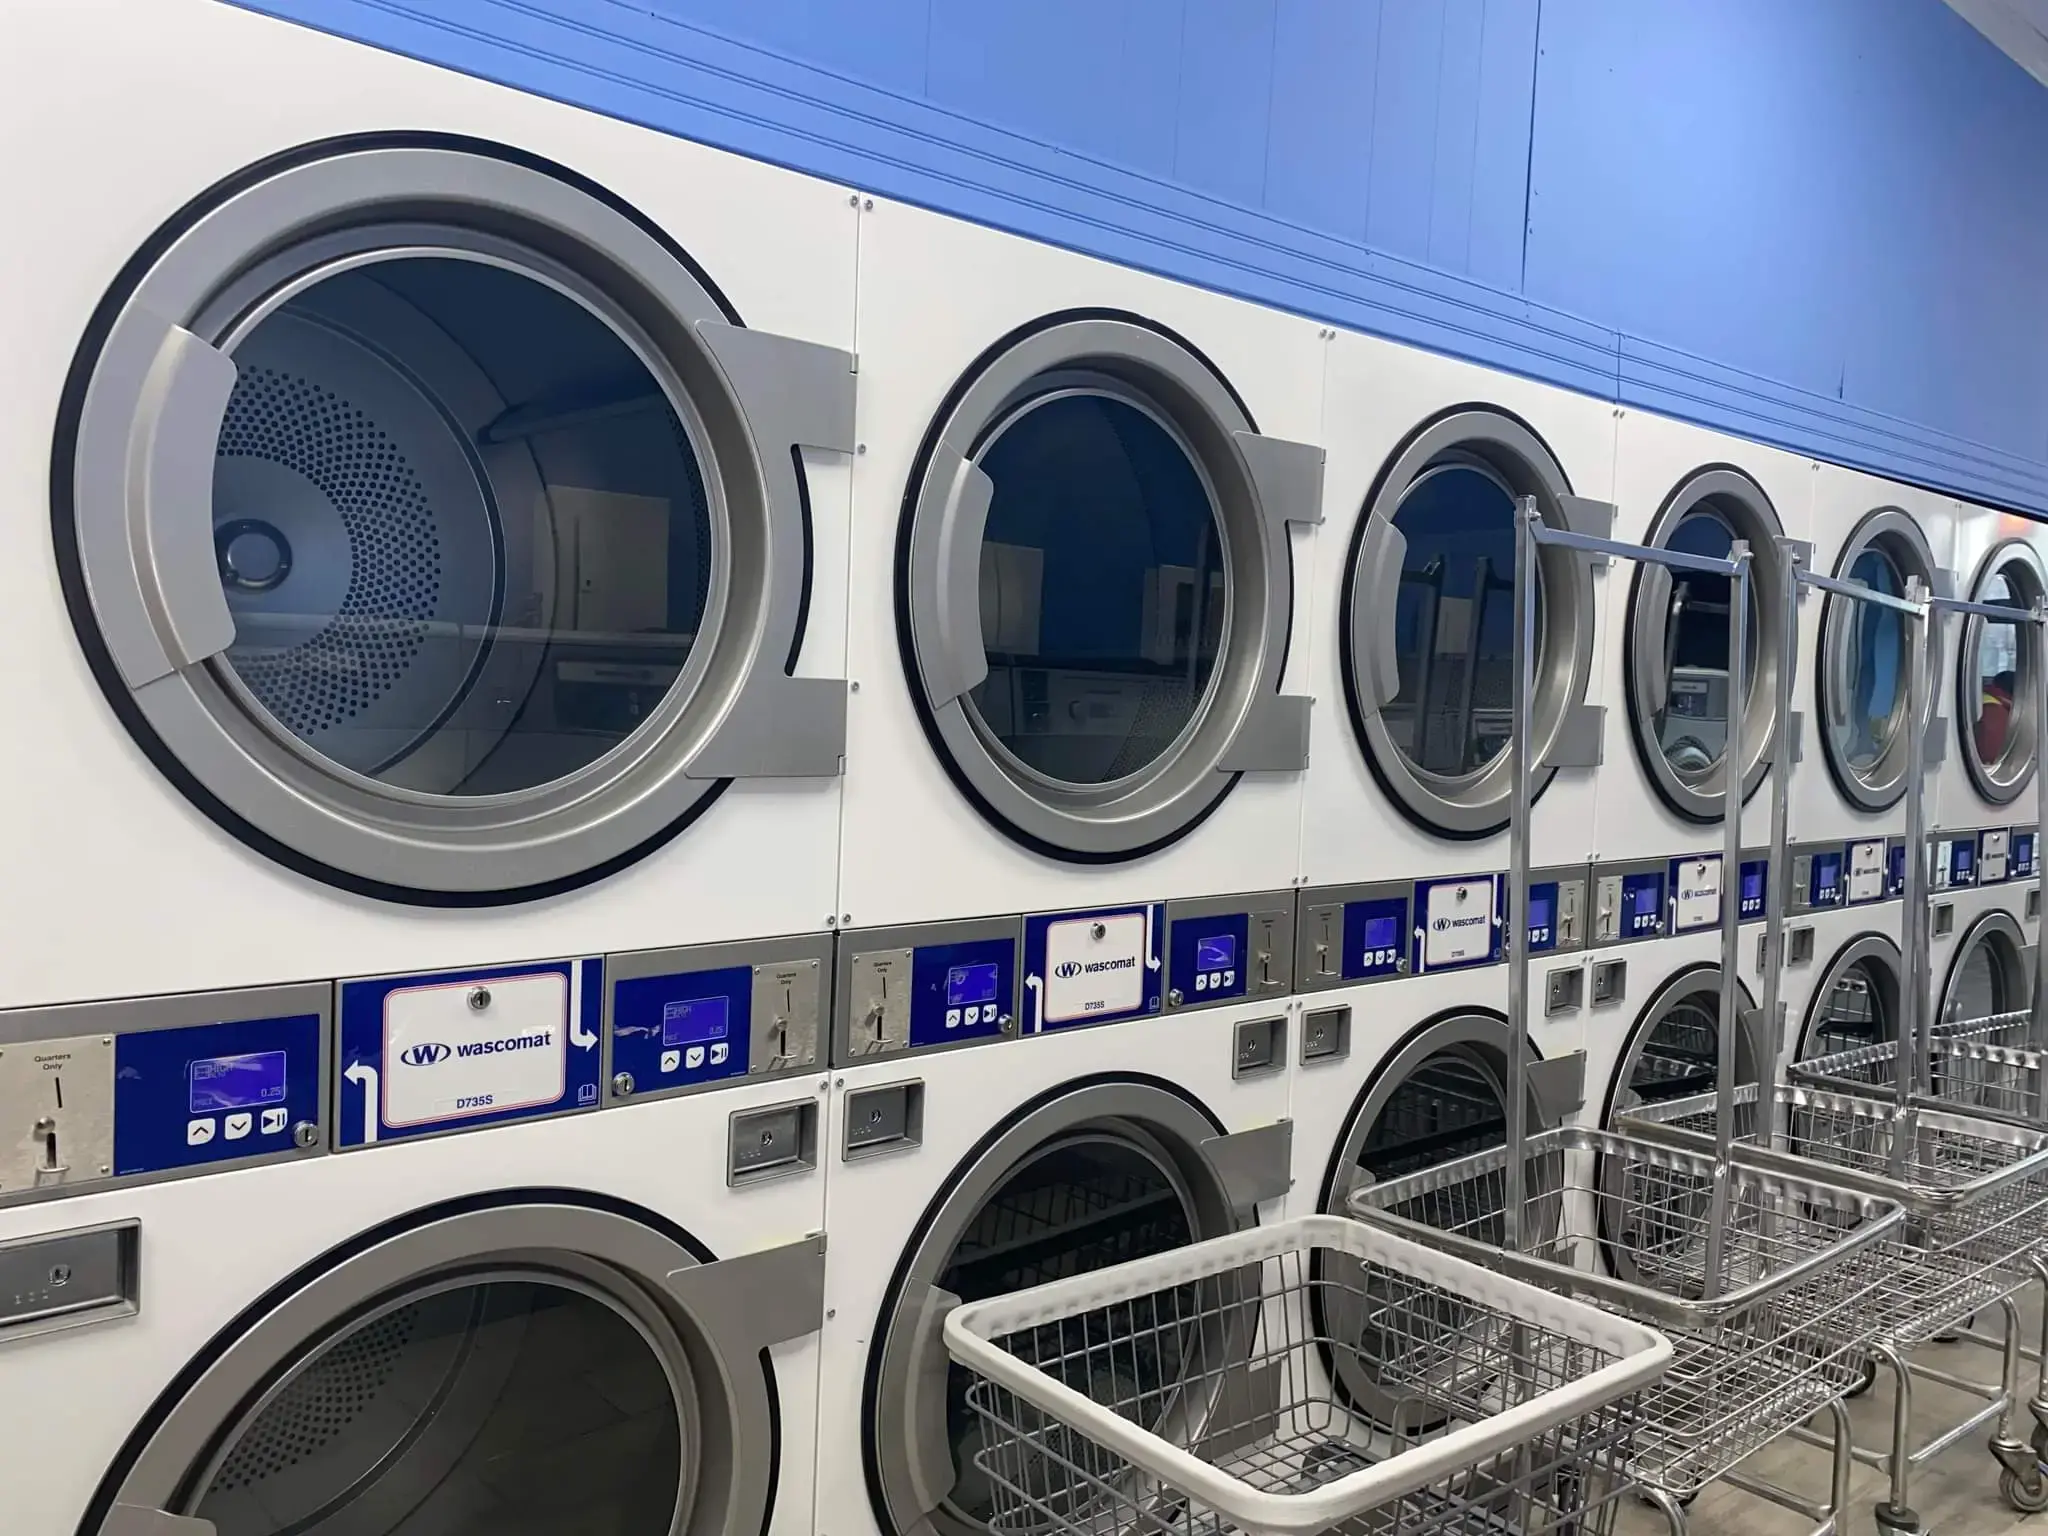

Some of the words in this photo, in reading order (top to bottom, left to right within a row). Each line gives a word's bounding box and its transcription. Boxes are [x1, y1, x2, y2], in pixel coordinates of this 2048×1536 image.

[1084, 956, 1136, 973] wascomat
[1085, 1000, 1105, 1011] D735S
[457, 1031, 551, 1058] wascomat
[34, 1054, 71, 1063] Quarters
[42, 1063, 63, 1071] Only
[260, 1086, 281, 1098] 0.25
[456, 1094, 494, 1109] D735S
